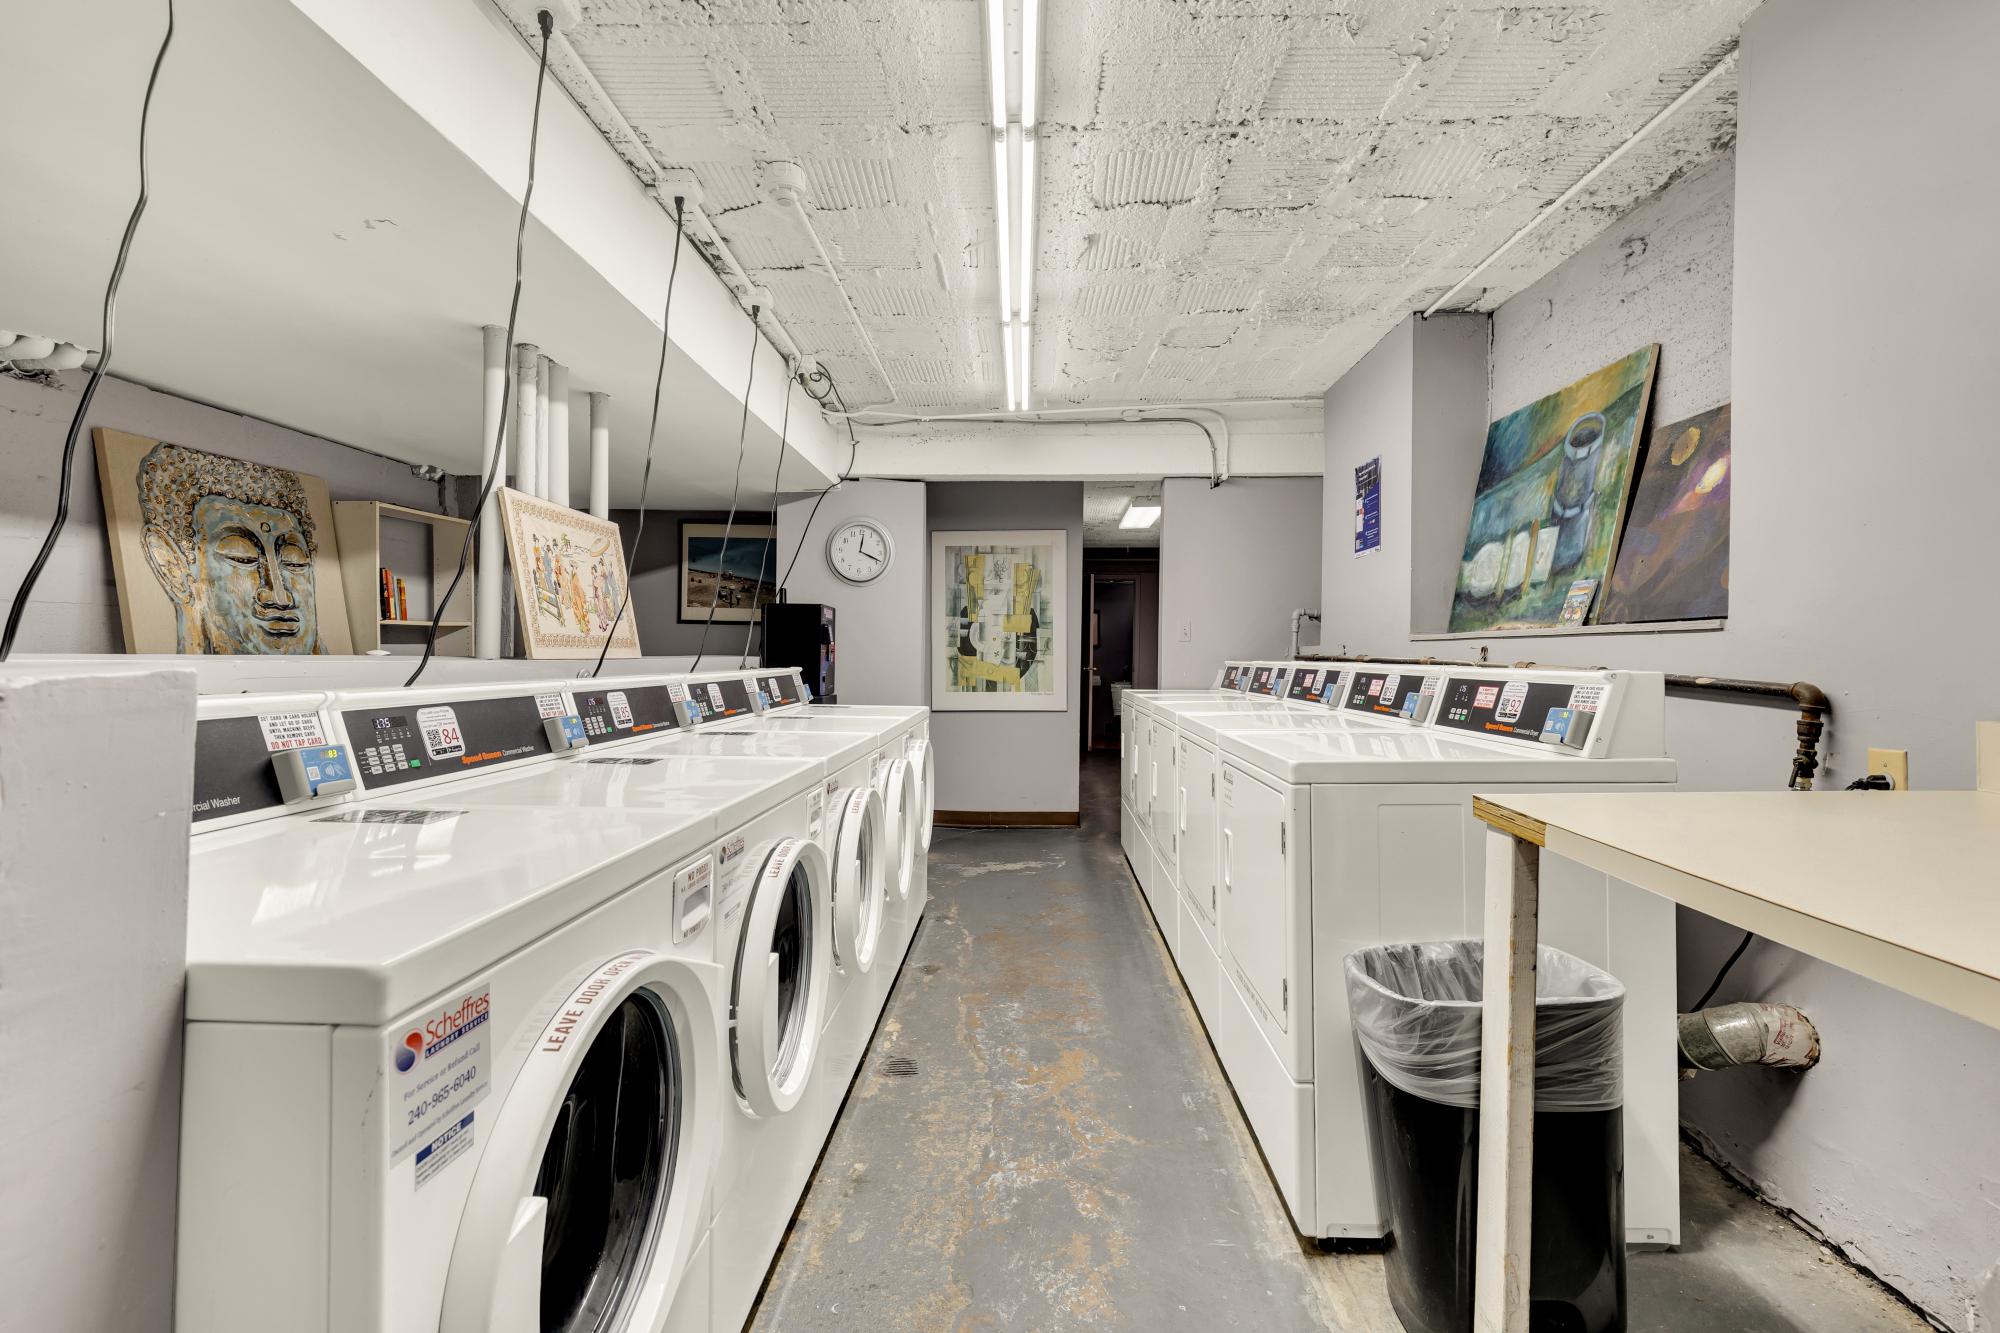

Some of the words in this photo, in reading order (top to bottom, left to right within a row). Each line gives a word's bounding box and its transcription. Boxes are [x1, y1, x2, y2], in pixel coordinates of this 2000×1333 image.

[281, 740, 293, 748] NOT
[307, 737, 322, 745] CARD
[442, 728, 459, 744] 84
[192, 800, 211, 812] rcial
[210, 796, 240, 808] Washer
[426, 993, 489, 1046] Scheffres
[542, 1010, 584, 1052] LEAVE
[575, 979, 611, 1005] DOOR
[602, 960, 636, 976] OPEN
[426, 1032, 459, 1058] LAUNDRY
[461, 1012, 488, 1034] SERVICE
[408, 1066, 476, 1126] 240-965-6040
[432, 1122, 462, 1152] NOTICE
